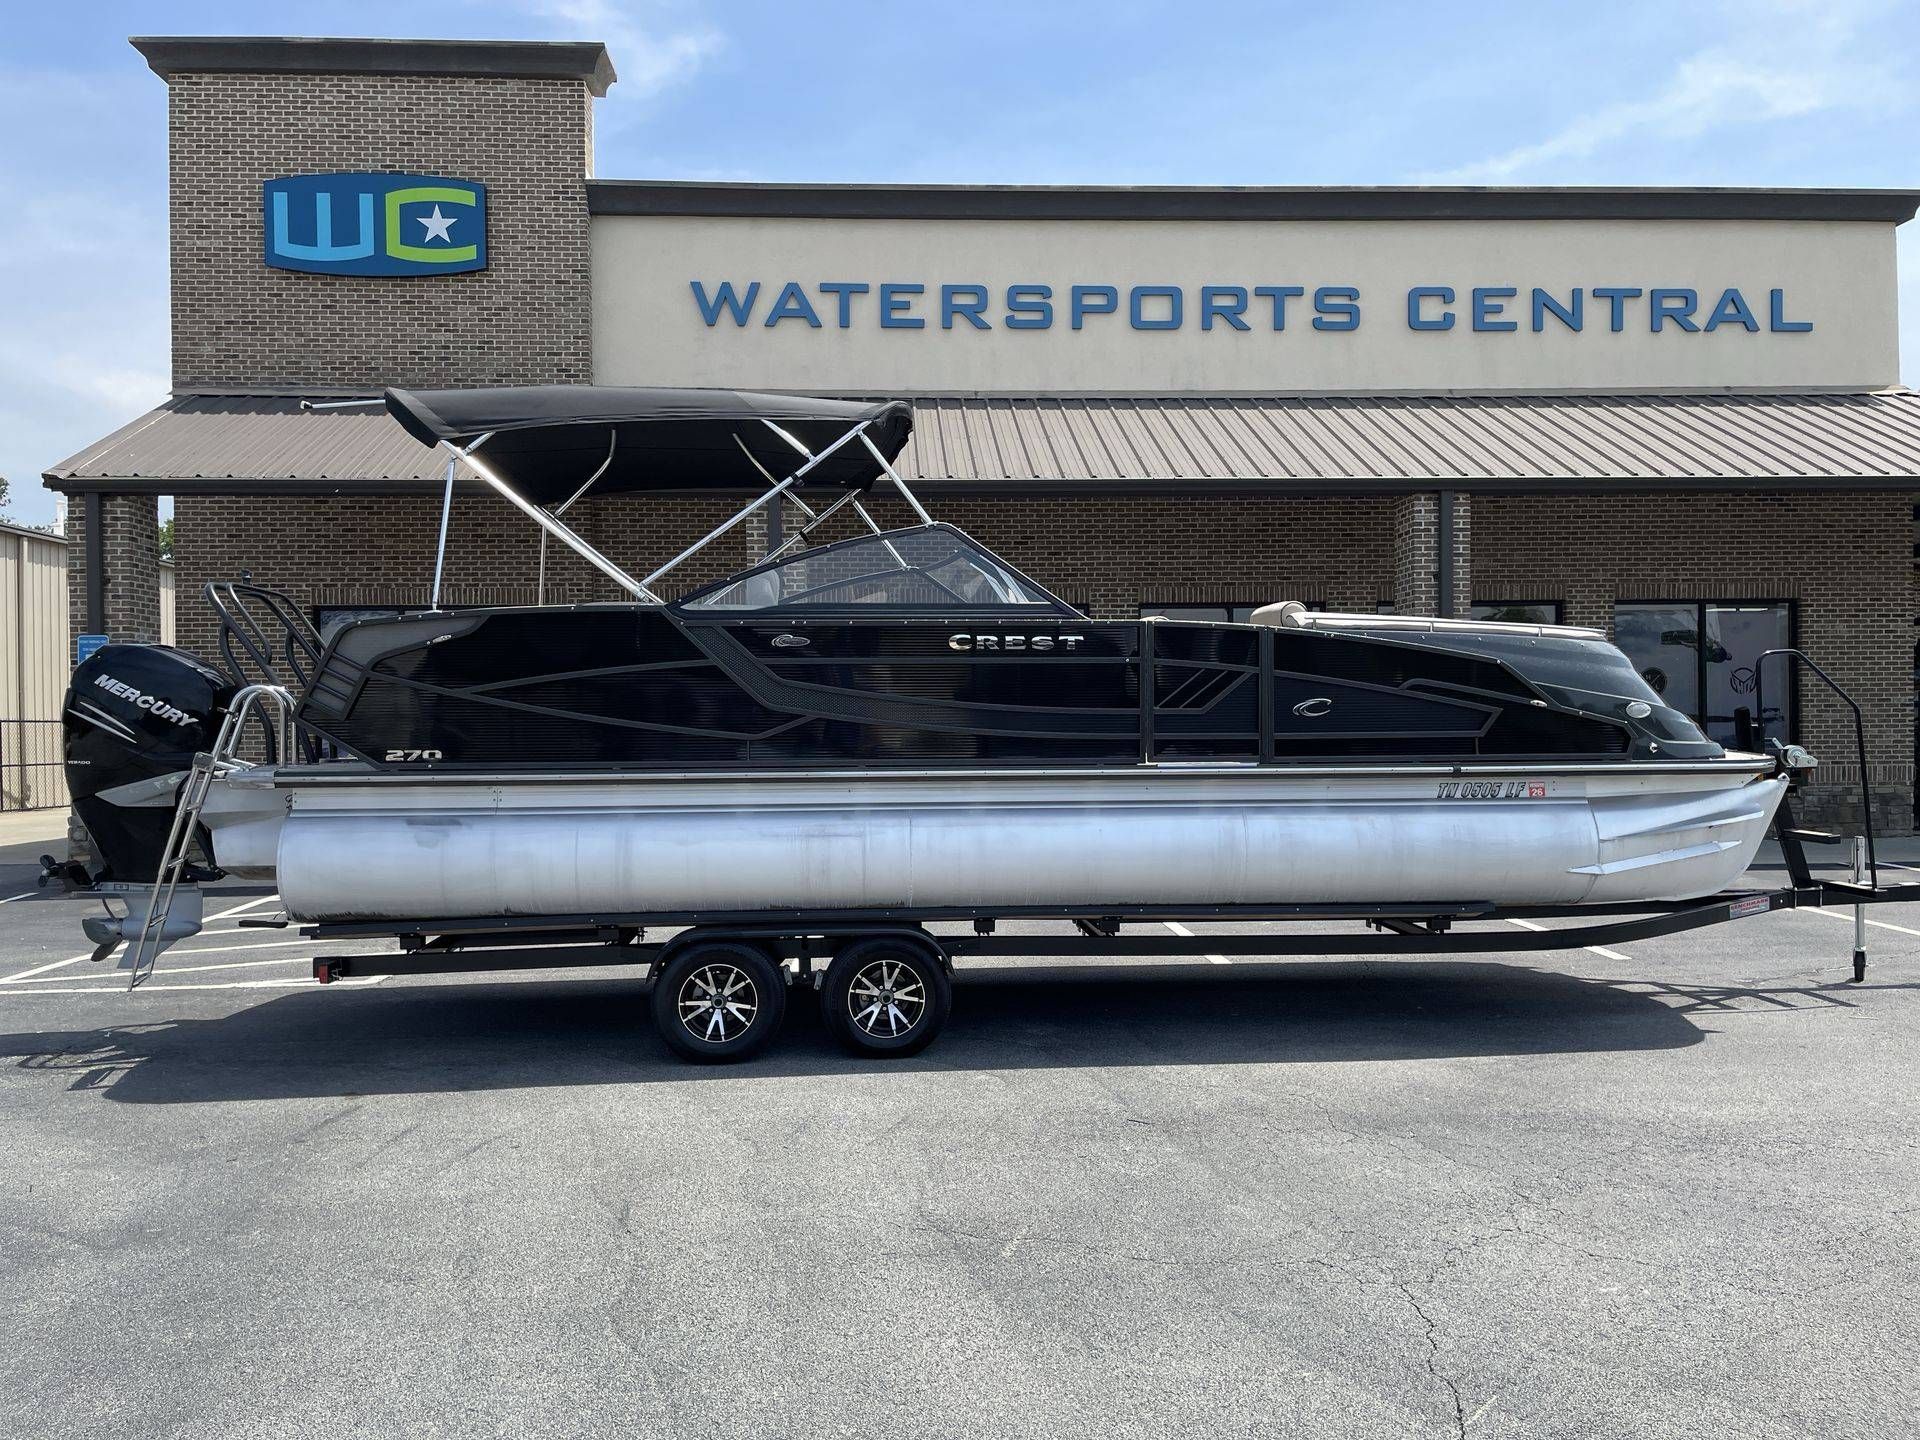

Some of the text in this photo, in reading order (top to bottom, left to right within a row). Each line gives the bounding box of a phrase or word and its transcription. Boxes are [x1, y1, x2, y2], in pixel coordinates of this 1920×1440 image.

[273, 187, 477, 263] WC
[690, 281, 1813, 333] WATERSPORTS CENTRAL
[948, 634, 1084, 650] CREST
[94, 673, 199, 727] MERCURY
[385, 749, 443, 762] 270
[1437, 781, 1526, 798] TN 0505 LF
[1532, 787, 1544, 796] 26
